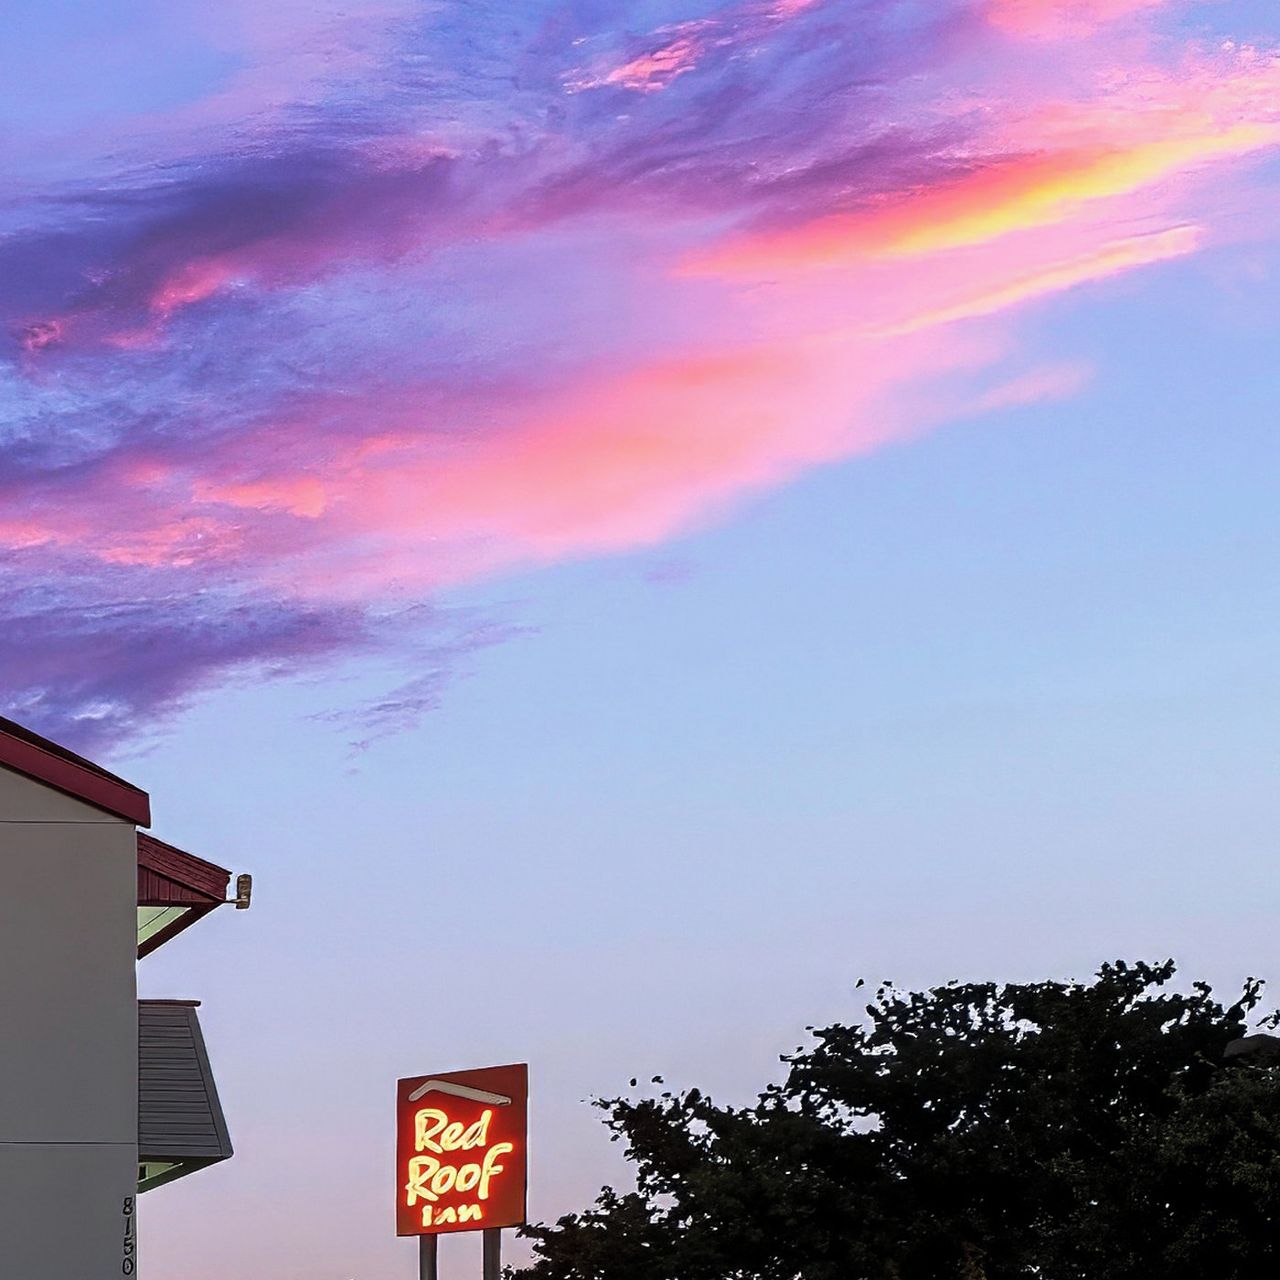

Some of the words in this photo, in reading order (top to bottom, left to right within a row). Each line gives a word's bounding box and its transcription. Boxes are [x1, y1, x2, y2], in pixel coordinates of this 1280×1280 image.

[415, 1109, 492, 1153] Red
[405, 1143, 513, 1206] Roof
[122, 1197, 134, 1275] 8150
